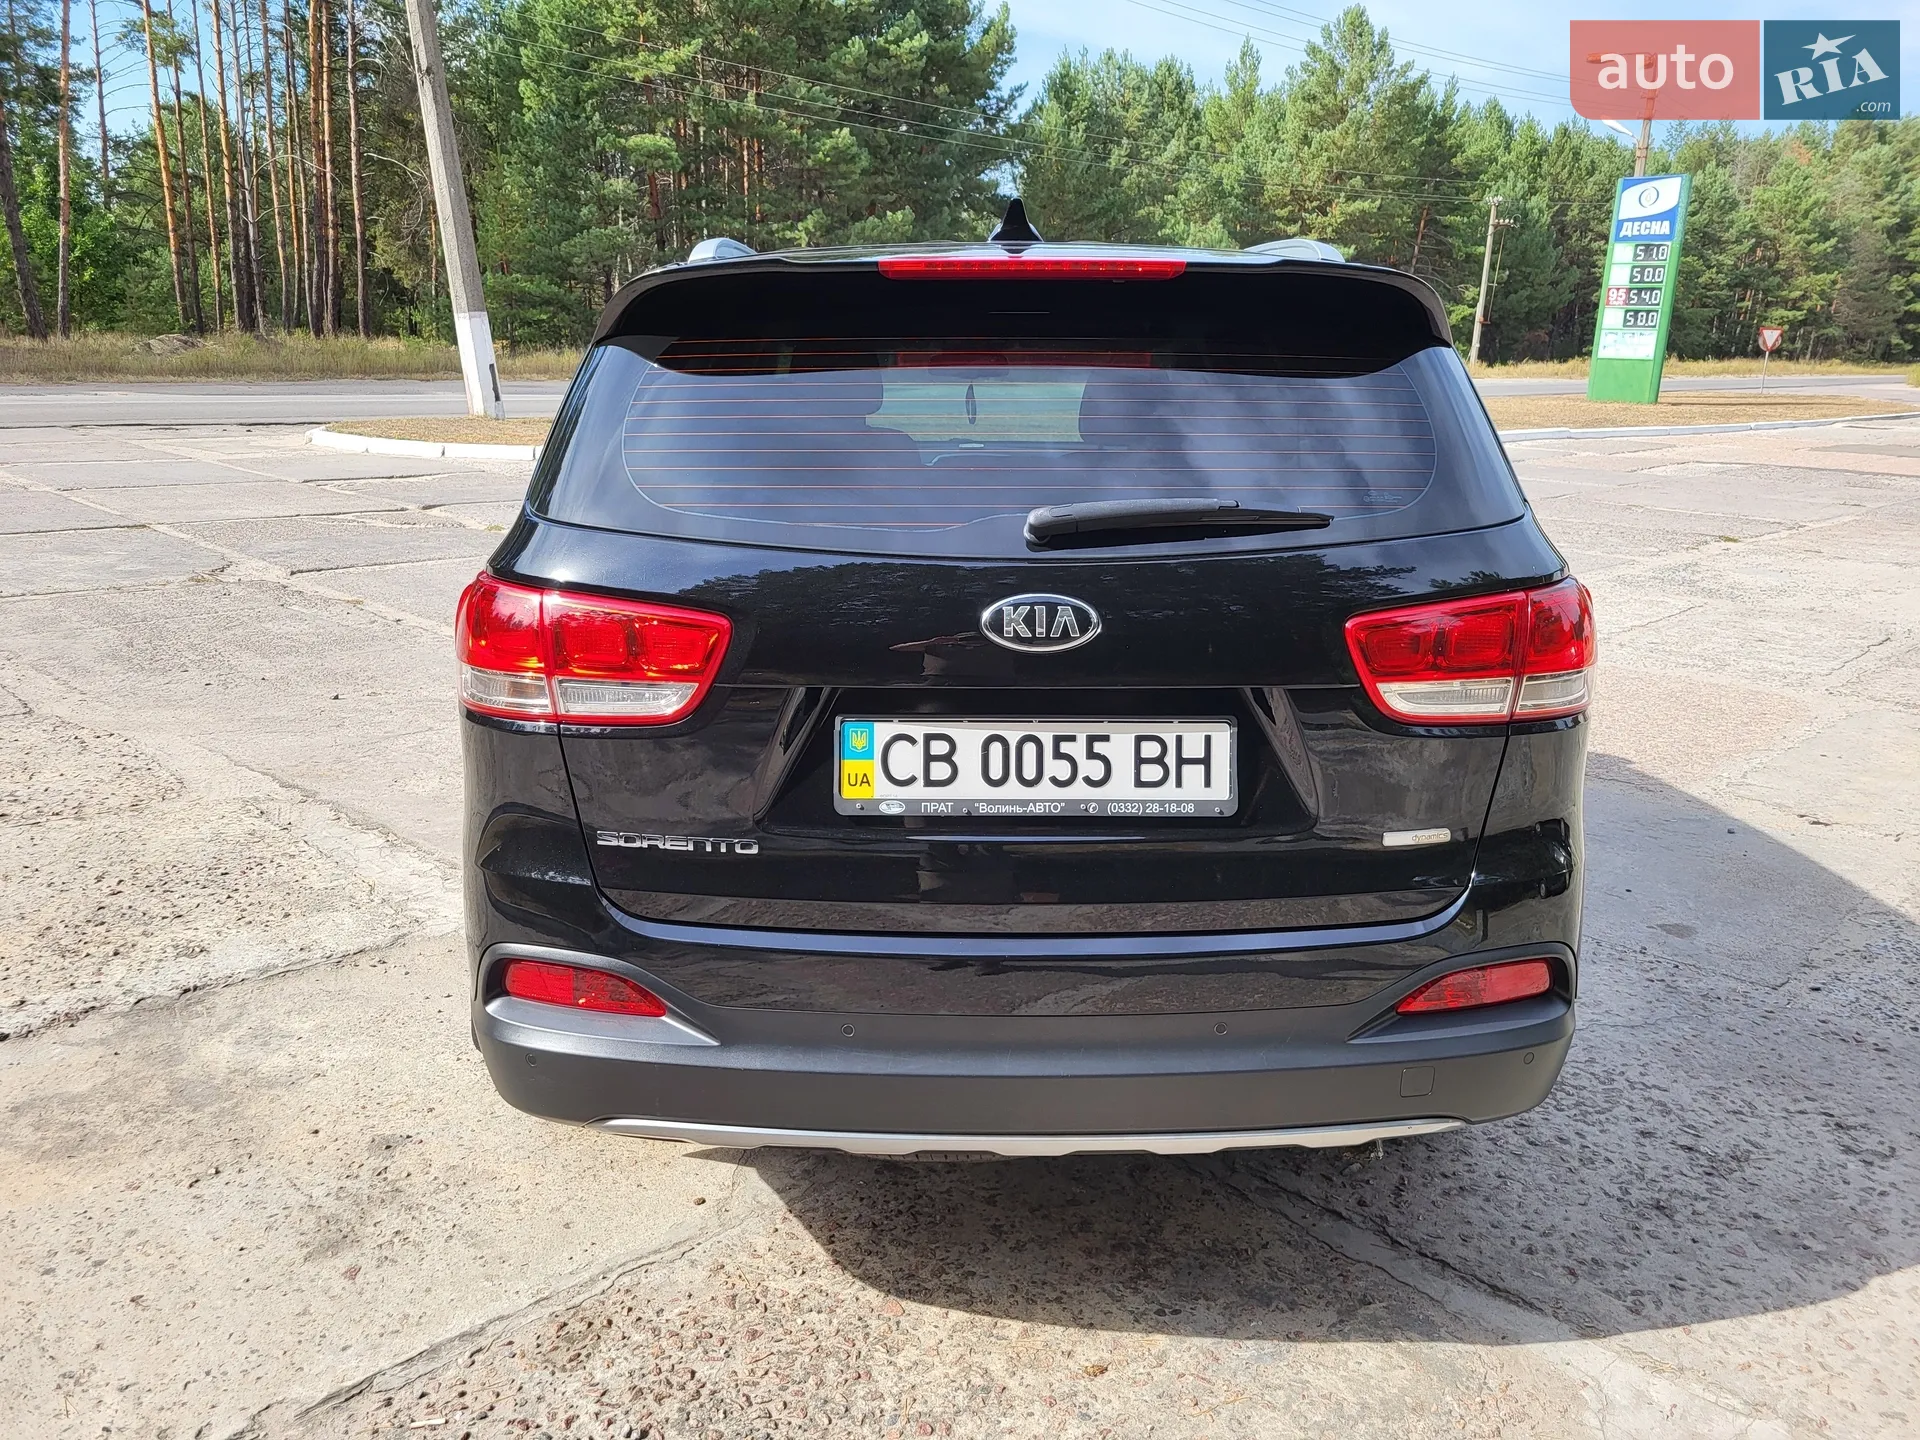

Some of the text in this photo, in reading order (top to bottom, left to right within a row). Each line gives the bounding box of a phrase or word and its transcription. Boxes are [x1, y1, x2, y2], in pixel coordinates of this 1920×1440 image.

[1619, 220, 1671, 238] ДЕСНА
[1608, 288, 1627, 301] 95
[1002, 605, 1080, 638] KIA
[880, 732, 1212, 789] CB 0055 BH
[847, 772, 871, 787] UA
[921, 802, 954, 813] ПРАТ
[1107, 802, 1143, 815] (0332)
[1145, 802, 1195, 813] 28-18-08
[596, 830, 759, 854] SORENTO
